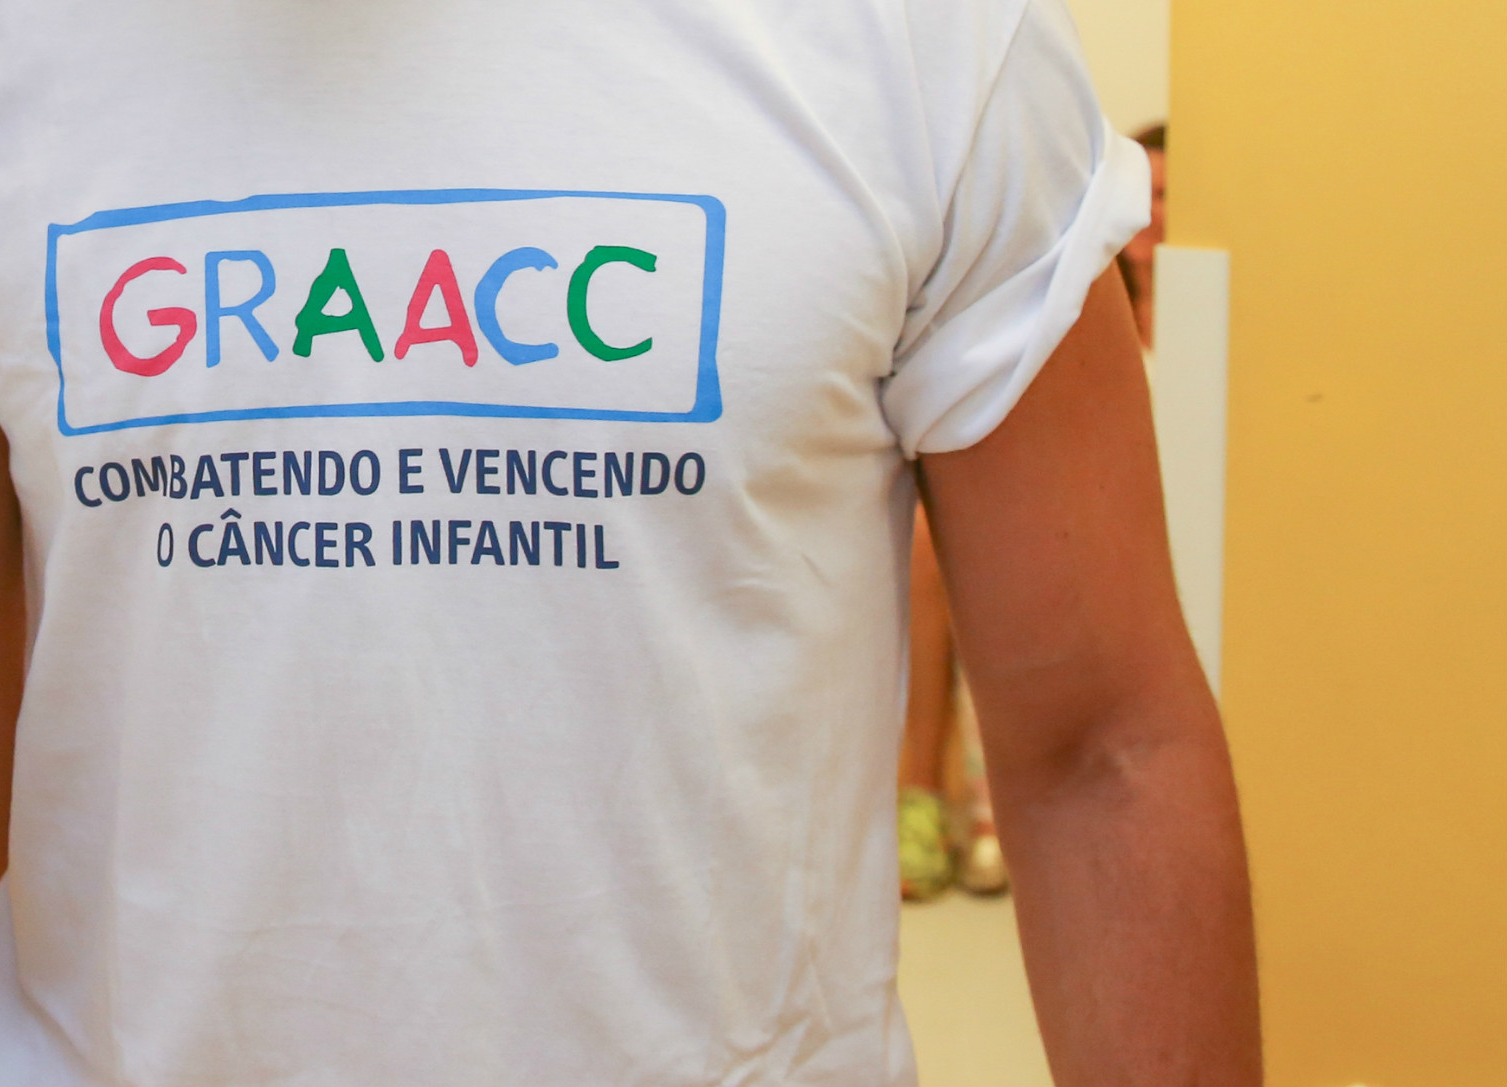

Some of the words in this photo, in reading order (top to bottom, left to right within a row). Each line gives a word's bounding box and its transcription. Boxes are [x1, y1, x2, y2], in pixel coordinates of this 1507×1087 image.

[99, 245, 657, 377] GRAACC
[73, 449, 381, 508] COMBATENDO
[398, 448, 425, 495] E
[438, 448, 706, 499] VENCENDO
[156, 522, 174, 568] O
[188, 507, 376, 568] CÂNCER
[392, 519, 620, 570] INFANTIL
